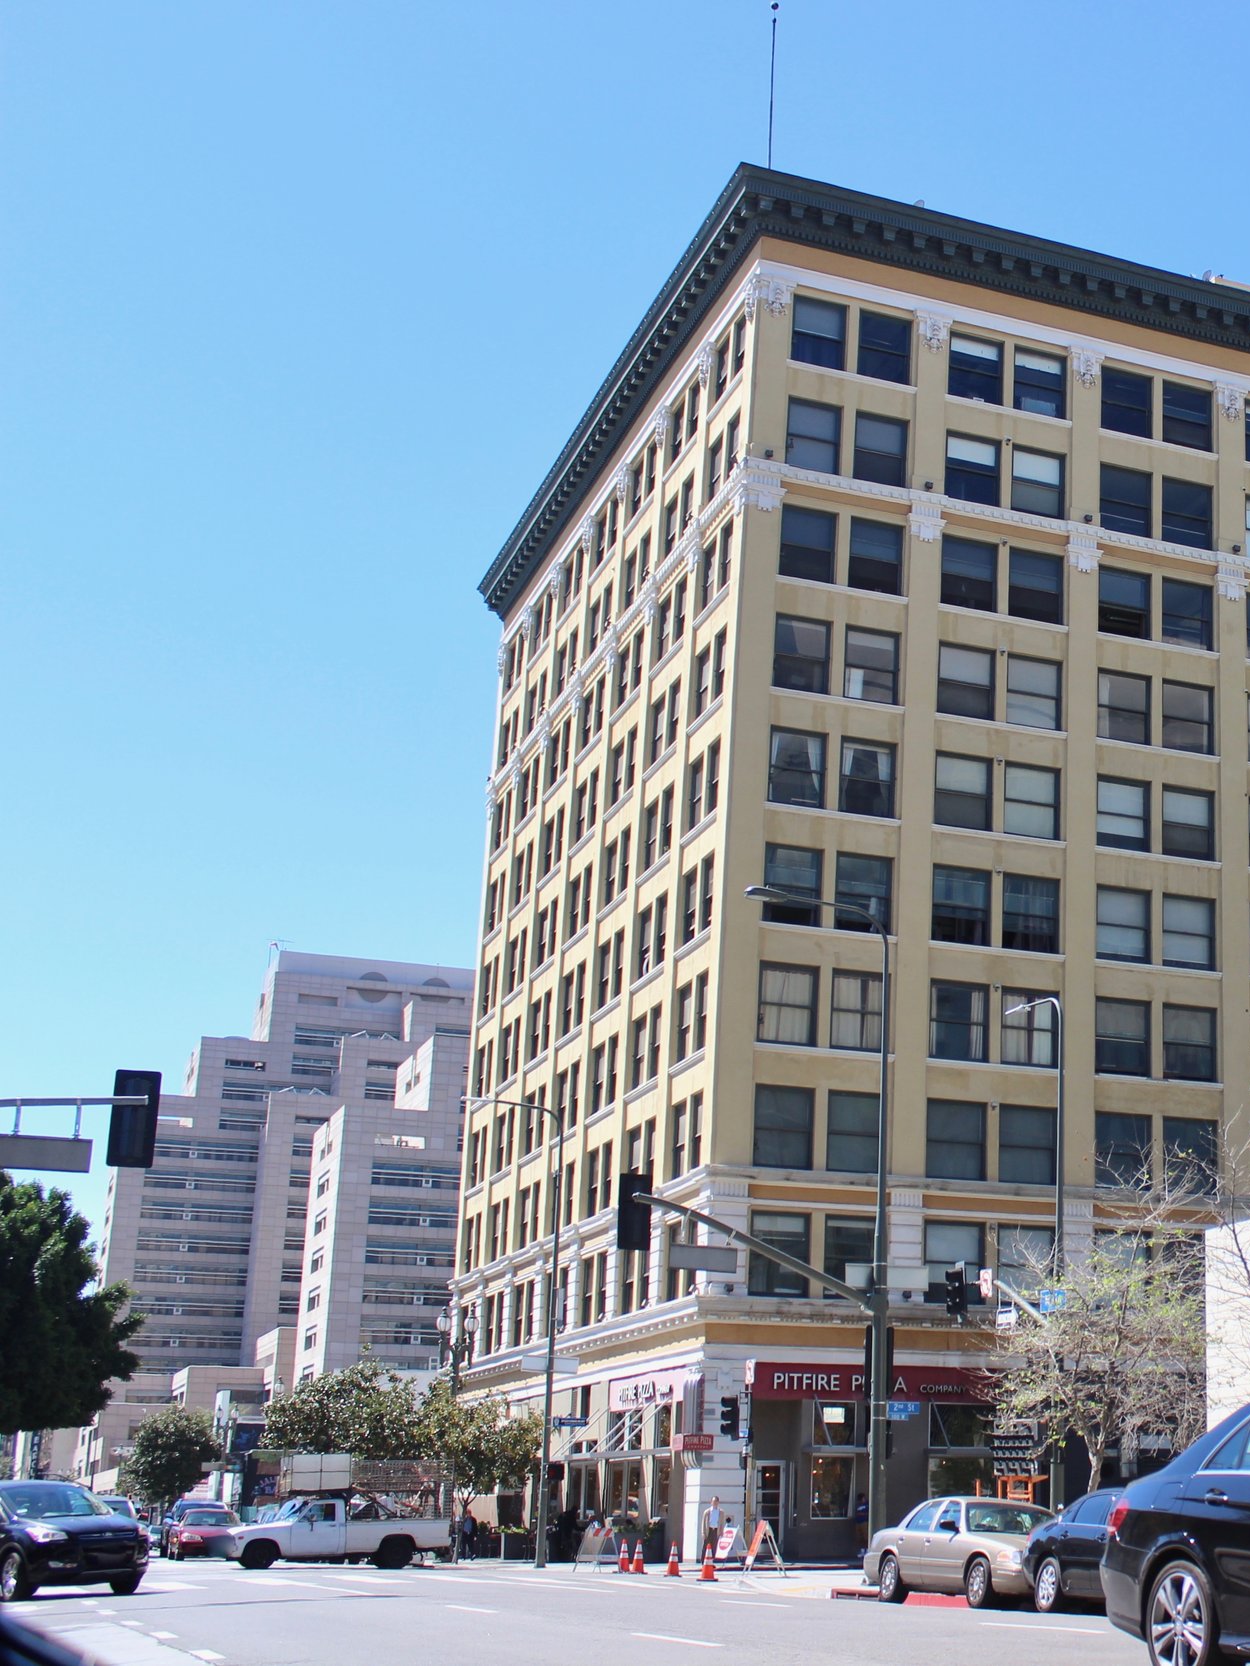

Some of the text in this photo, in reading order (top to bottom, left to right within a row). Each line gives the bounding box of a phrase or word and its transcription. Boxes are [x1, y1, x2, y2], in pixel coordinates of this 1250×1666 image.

[638, 1380, 655, 1398] PIZZA
[773, 1372, 967, 1394] PITFIRE PIA COMPANY
[893, 1402, 915, 1412] 2nd St
